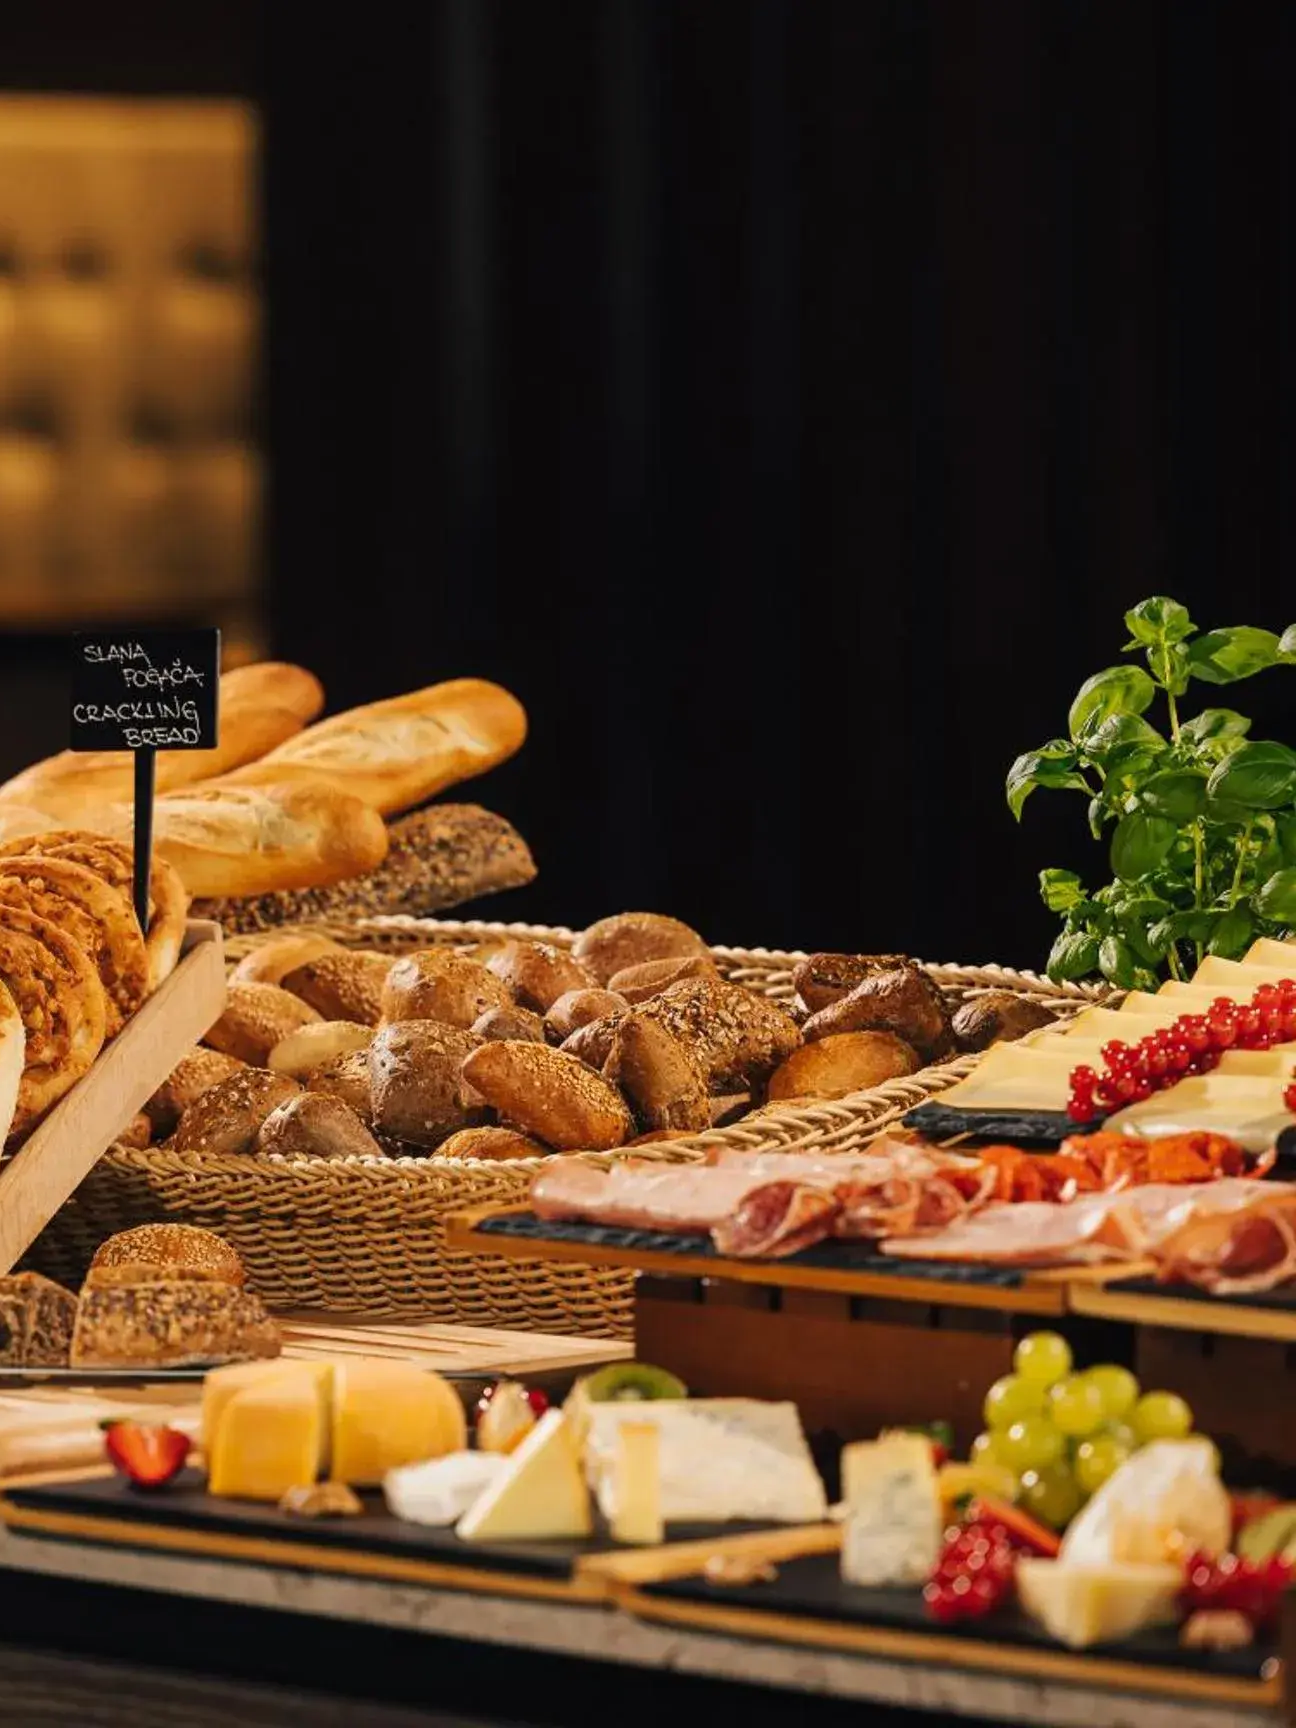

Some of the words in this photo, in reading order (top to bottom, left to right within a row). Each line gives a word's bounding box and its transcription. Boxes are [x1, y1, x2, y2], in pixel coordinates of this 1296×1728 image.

[83, 642, 152, 668] SLANA
[122, 657, 205, 692] POGAČA
[73, 695, 202, 735] CRACKLING
[122, 727, 200, 748] BREAD
